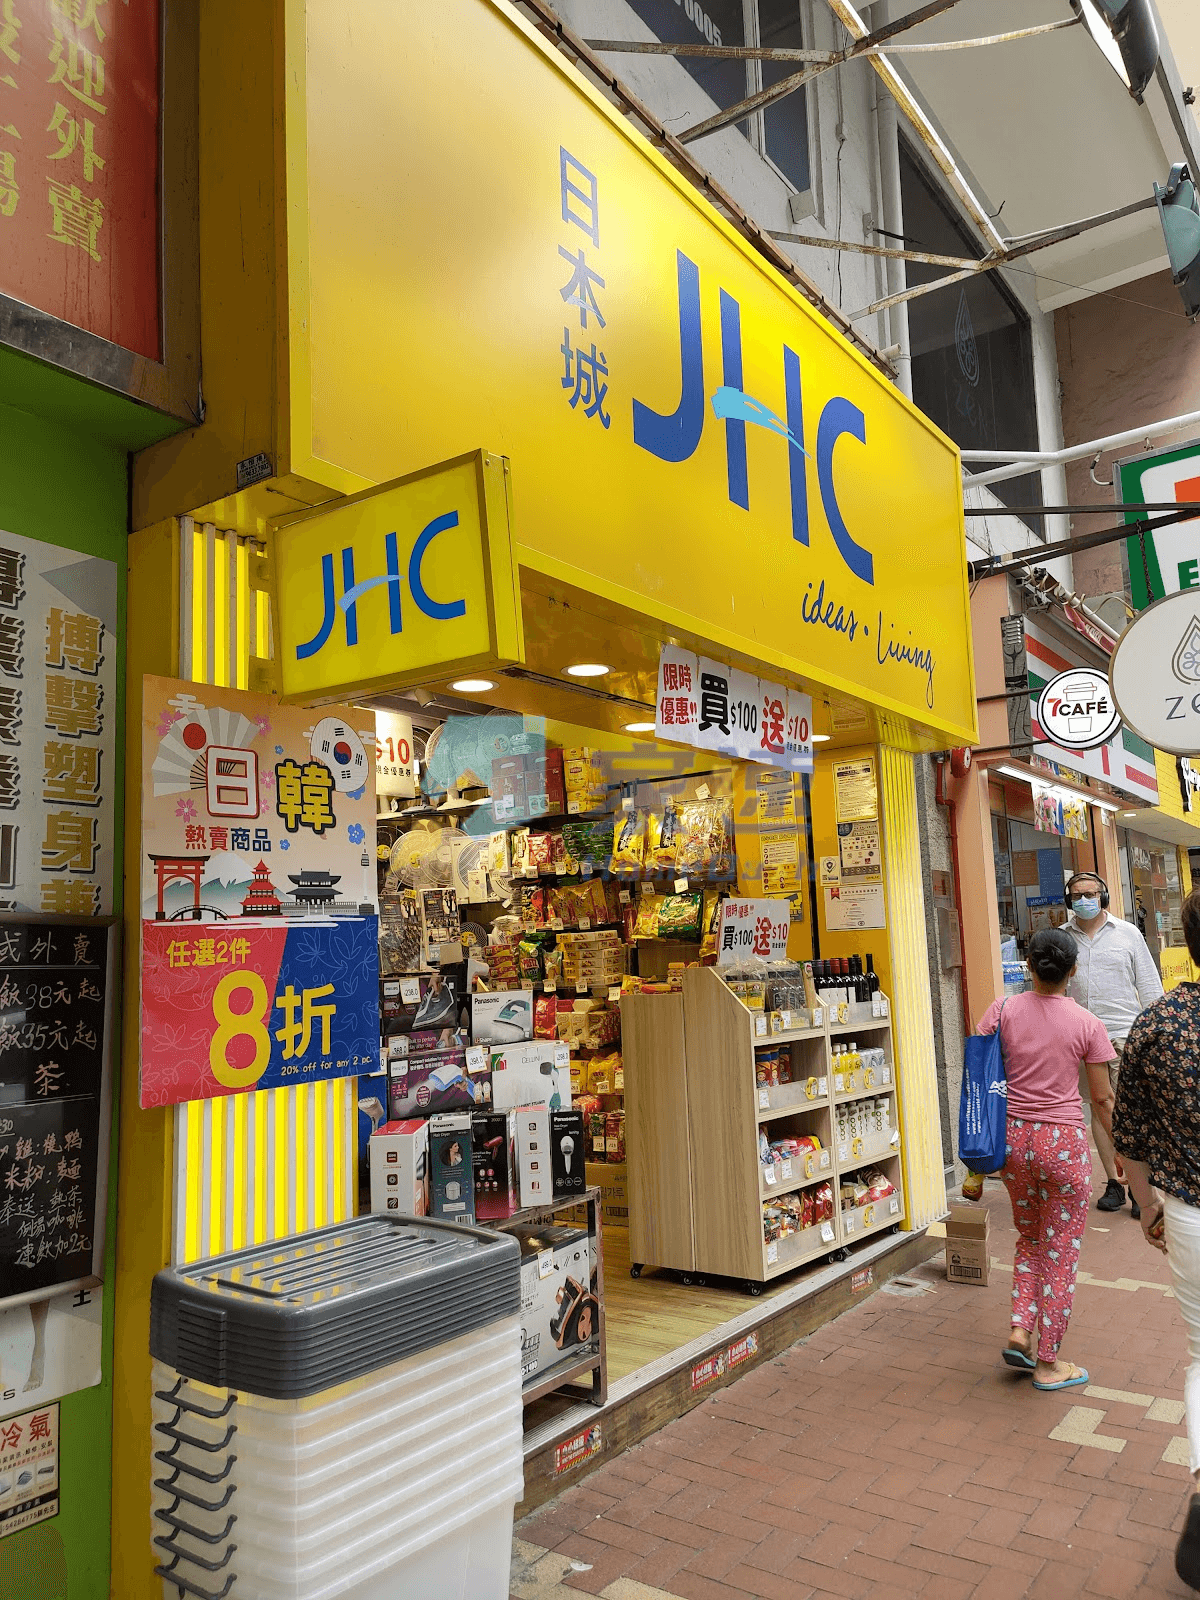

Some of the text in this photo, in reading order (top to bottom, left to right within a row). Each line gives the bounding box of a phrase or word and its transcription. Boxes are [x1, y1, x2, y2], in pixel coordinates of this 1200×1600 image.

[557, 145, 611, 431] 日本城
[632, 247, 875, 587] JHC
[295, 509, 466, 660] JHC
[801, 579, 858, 642] ideas
[662, 662, 692, 693] 限時
[184, 824, 272, 853] 熱賣商品
[166, 937, 252, 968] 任選2件
[474, 996, 500, 1005] Panasonic
[281, 1066, 300, 1076] 20%
[302, 1062, 317, 1073] off
[320, 1060, 334, 1070] for
[336, 1059, 350, 1069] any
[353, 1056, 359, 1065] 2
[0, 1412, 52, 1452] 冷氣
